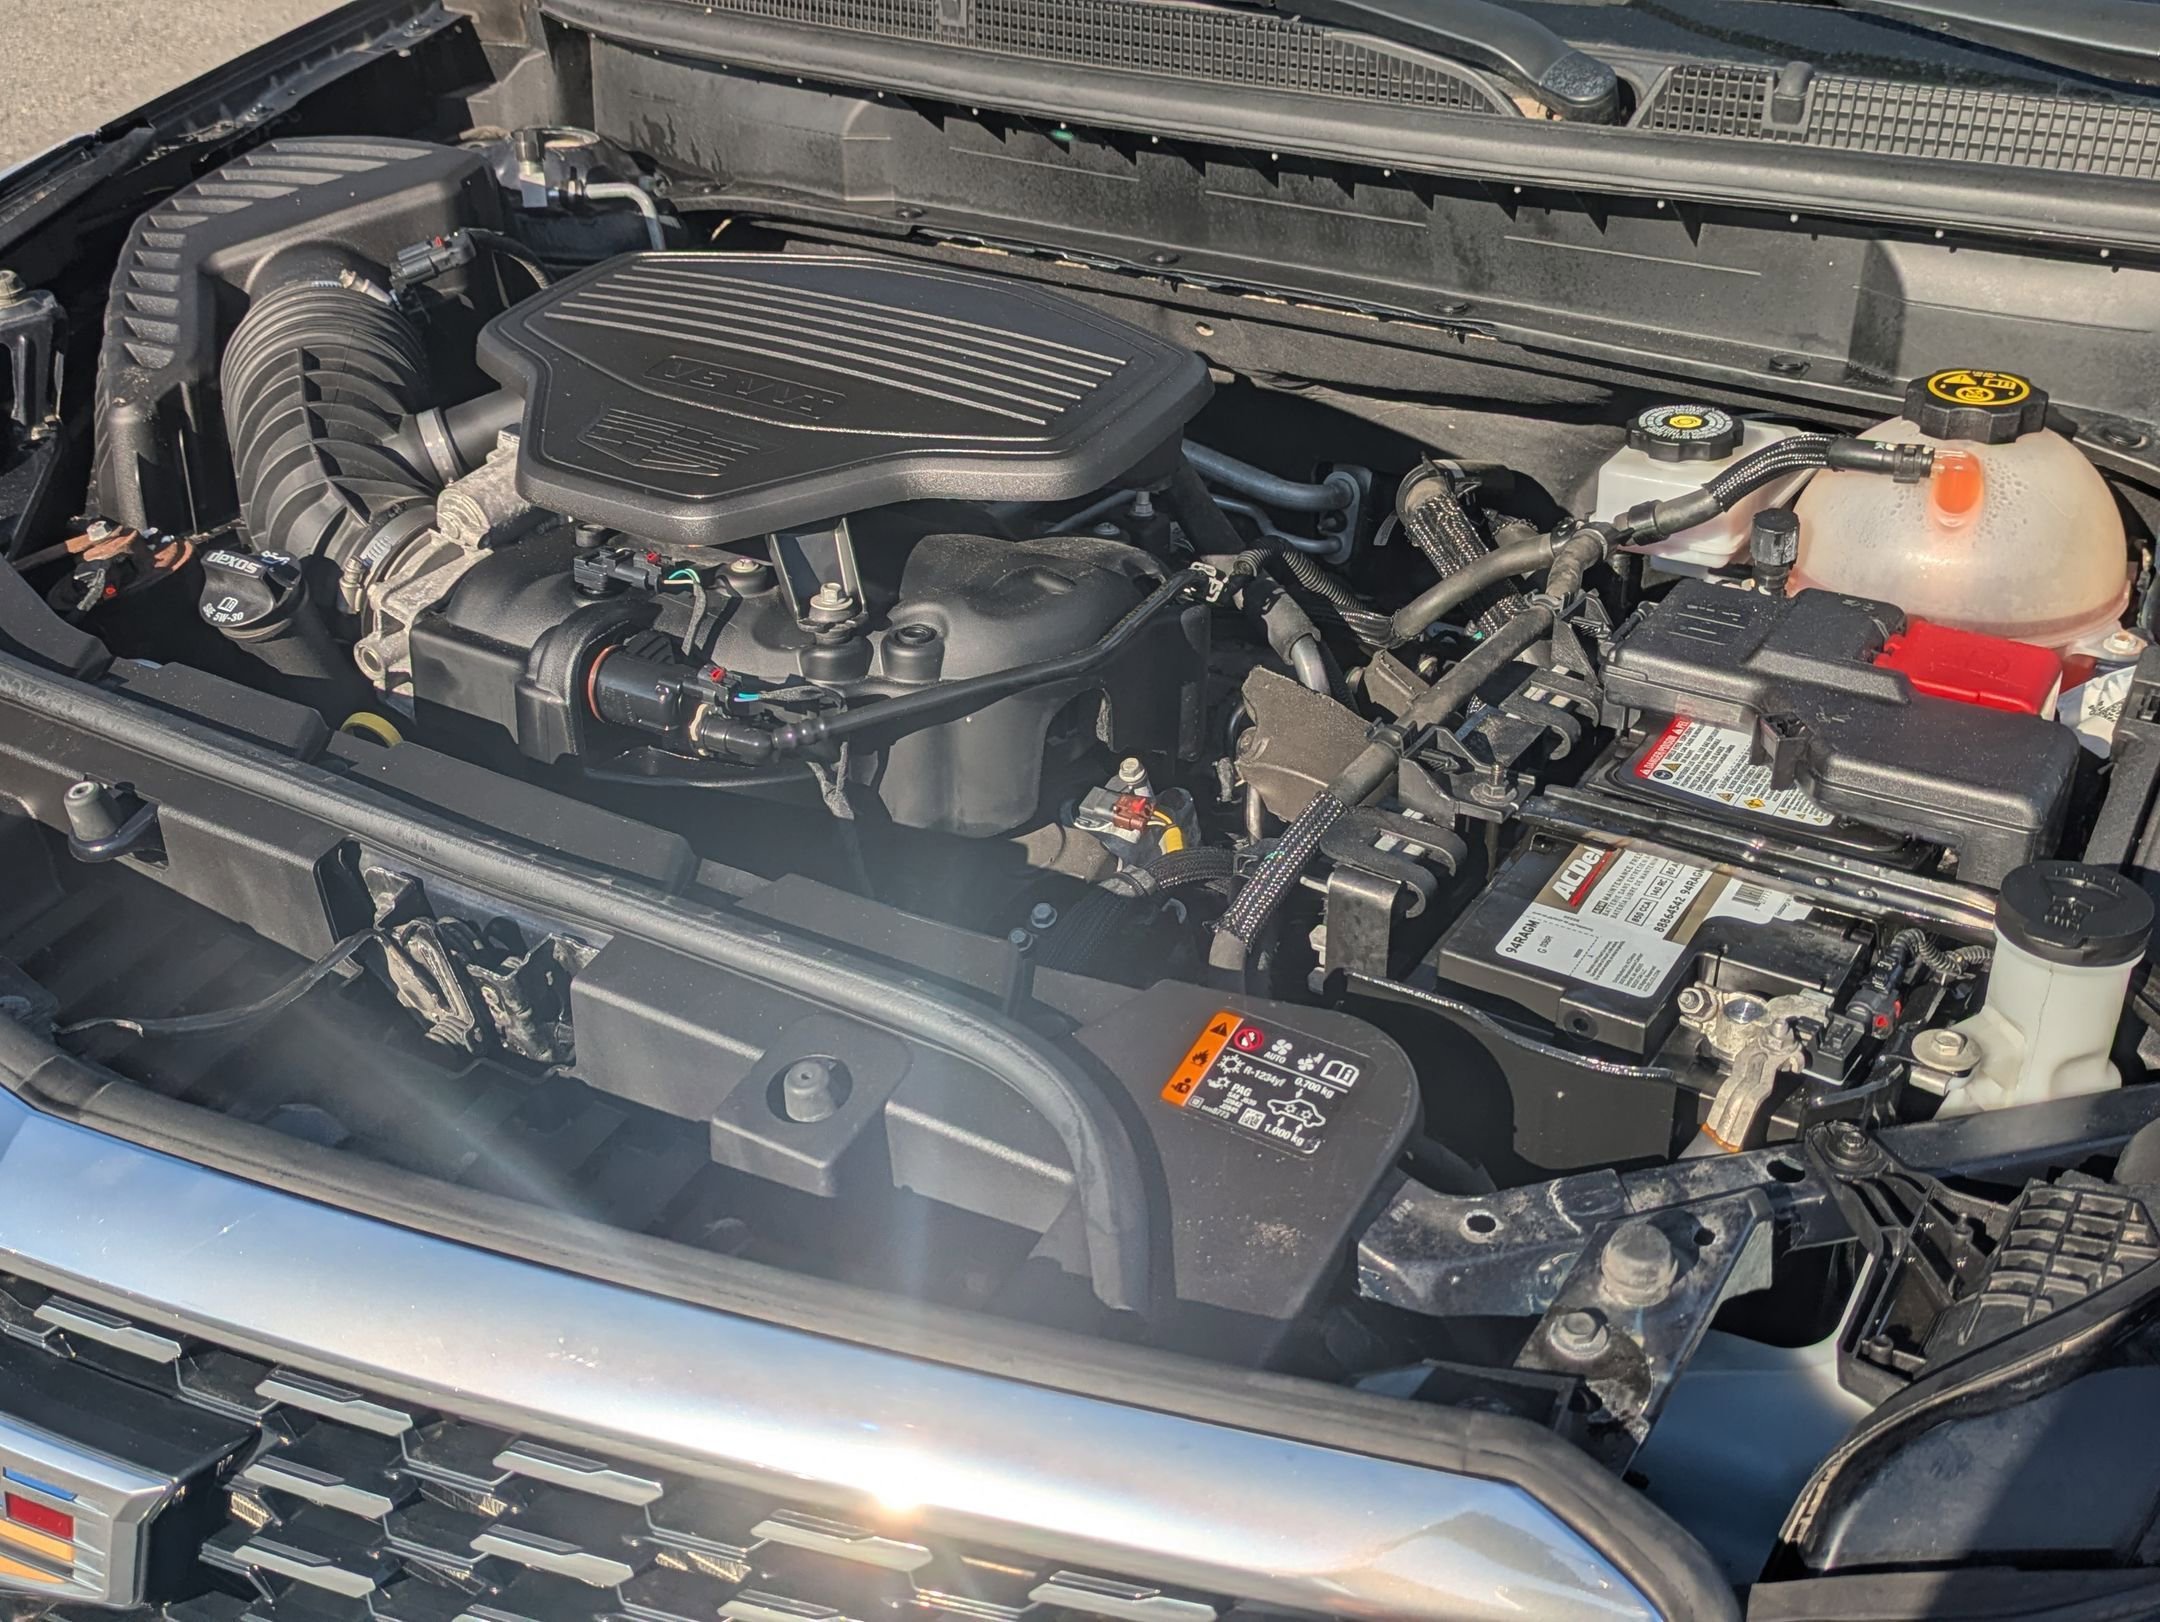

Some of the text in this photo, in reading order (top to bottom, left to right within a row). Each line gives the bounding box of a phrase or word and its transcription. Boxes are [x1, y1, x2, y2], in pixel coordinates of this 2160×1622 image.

[206, 550, 263, 573] dexos
[213, 611, 244, 623] 5W-30
[1665, 867, 1676, 875] 80
[1602, 865, 1634, 901] MAINTENANCE
[1650, 878, 1668, 896] 140 RC
[1632, 902, 1652, 923] 850 CCA
[1653, 896, 1686, 933] 88864542
[1505, 919, 1540, 954] 94RAGM
[1263, 1051, 1287, 1064] AUTO
[1243, 1065, 1287, 1087] R-1234yf
[1231, 1083, 1253, 1097] PAG
[1294, 1077, 1335, 1099] 0.700 kg
[1264, 1124, 1305, 1147] 1.000 kg
